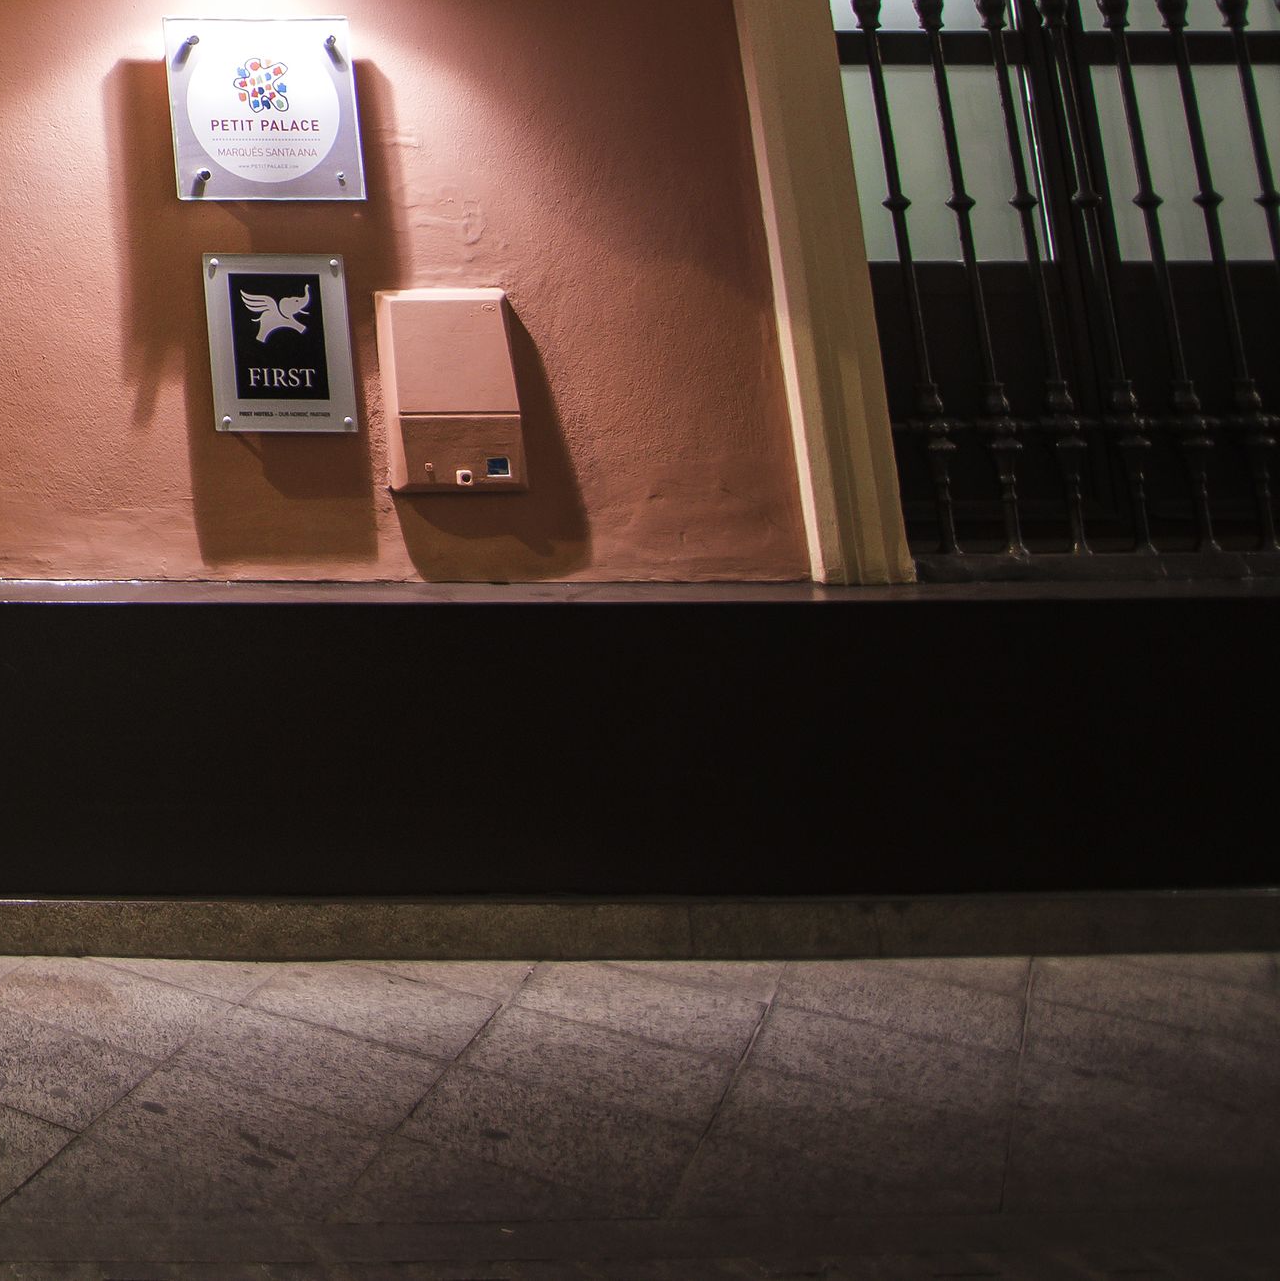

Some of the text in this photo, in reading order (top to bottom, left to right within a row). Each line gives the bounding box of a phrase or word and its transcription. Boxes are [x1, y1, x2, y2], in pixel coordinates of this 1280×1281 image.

[211, 119, 320, 132] PETIT PALACE
[217, 145, 318, 157] MARQUÉS SANTA ANA
[248, 368, 316, 388] FIRST
